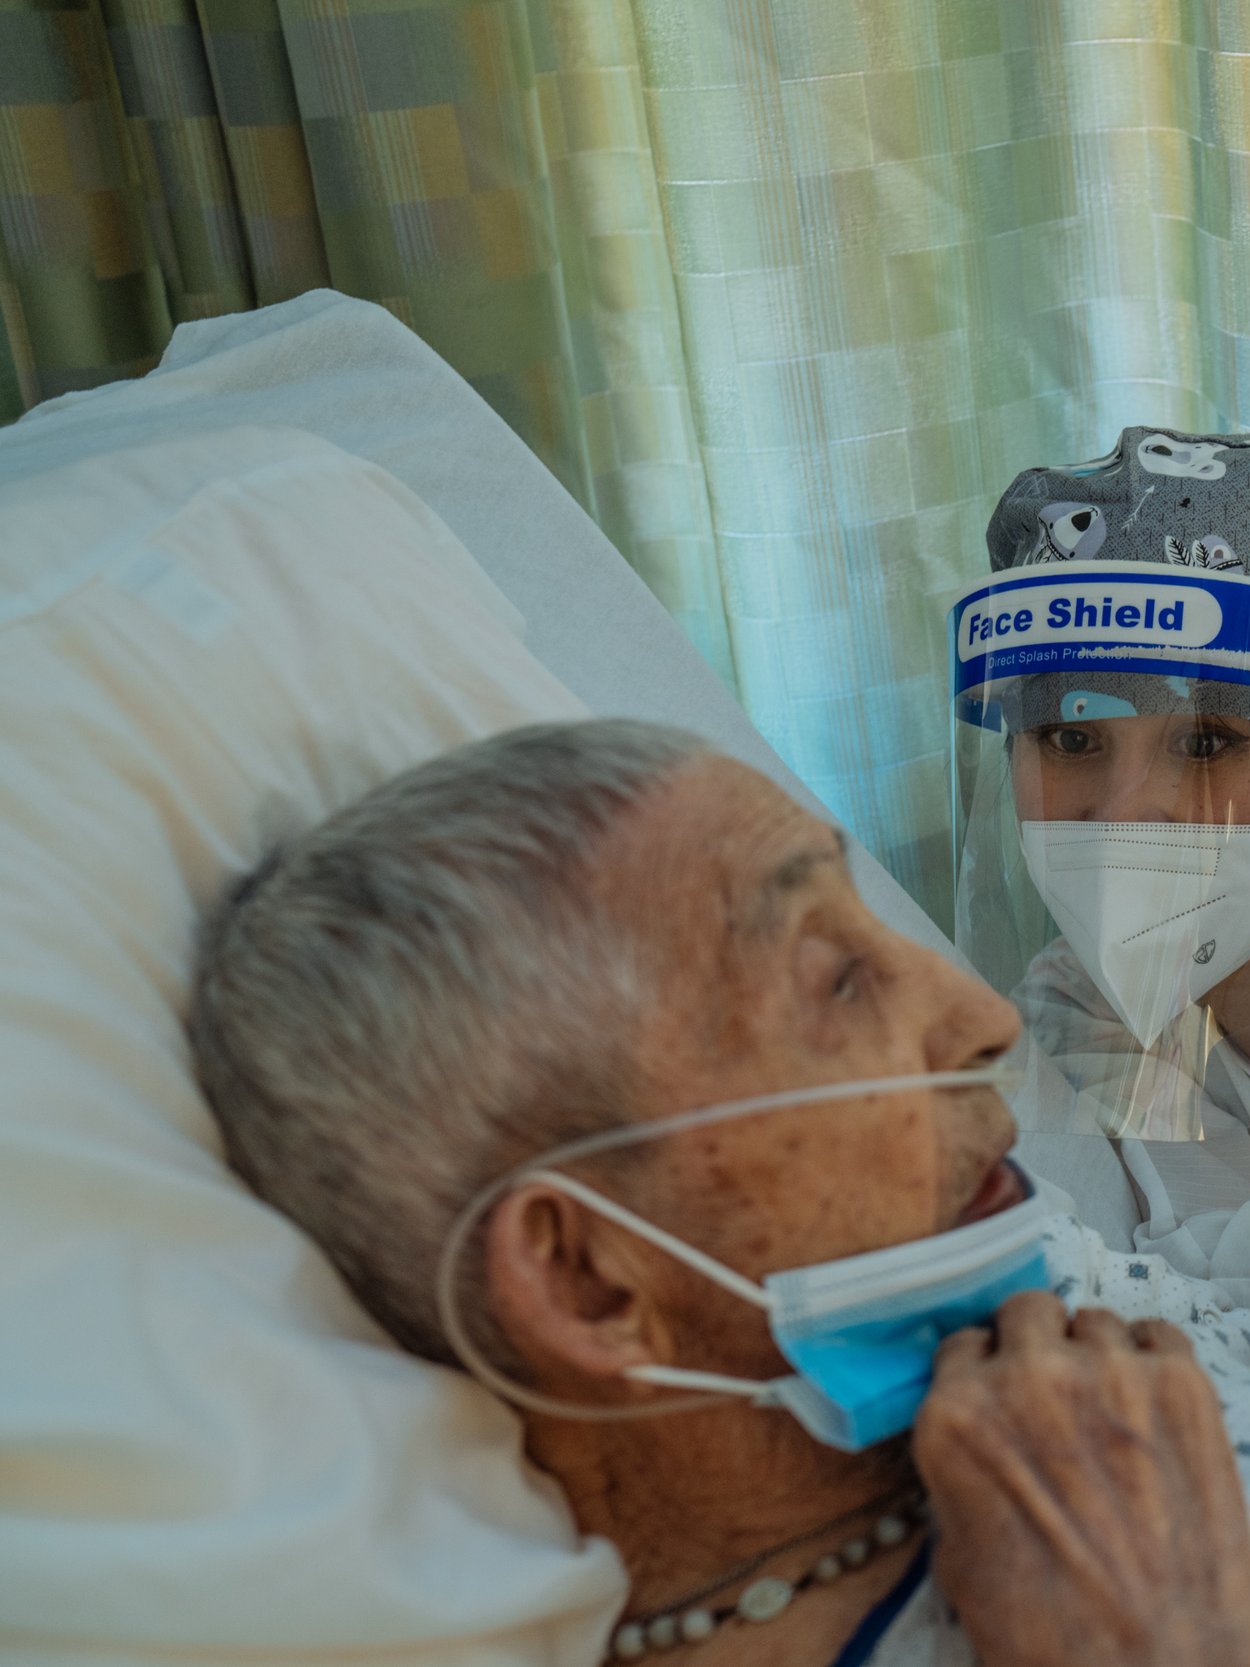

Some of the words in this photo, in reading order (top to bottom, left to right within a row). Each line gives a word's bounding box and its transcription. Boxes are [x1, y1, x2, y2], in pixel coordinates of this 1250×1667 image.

[968, 608, 1034, 646] Face
[1046, 597, 1185, 632] Shield
[988, 653, 1016, 669] Direct
[1018, 649, 1058, 665] Splash
